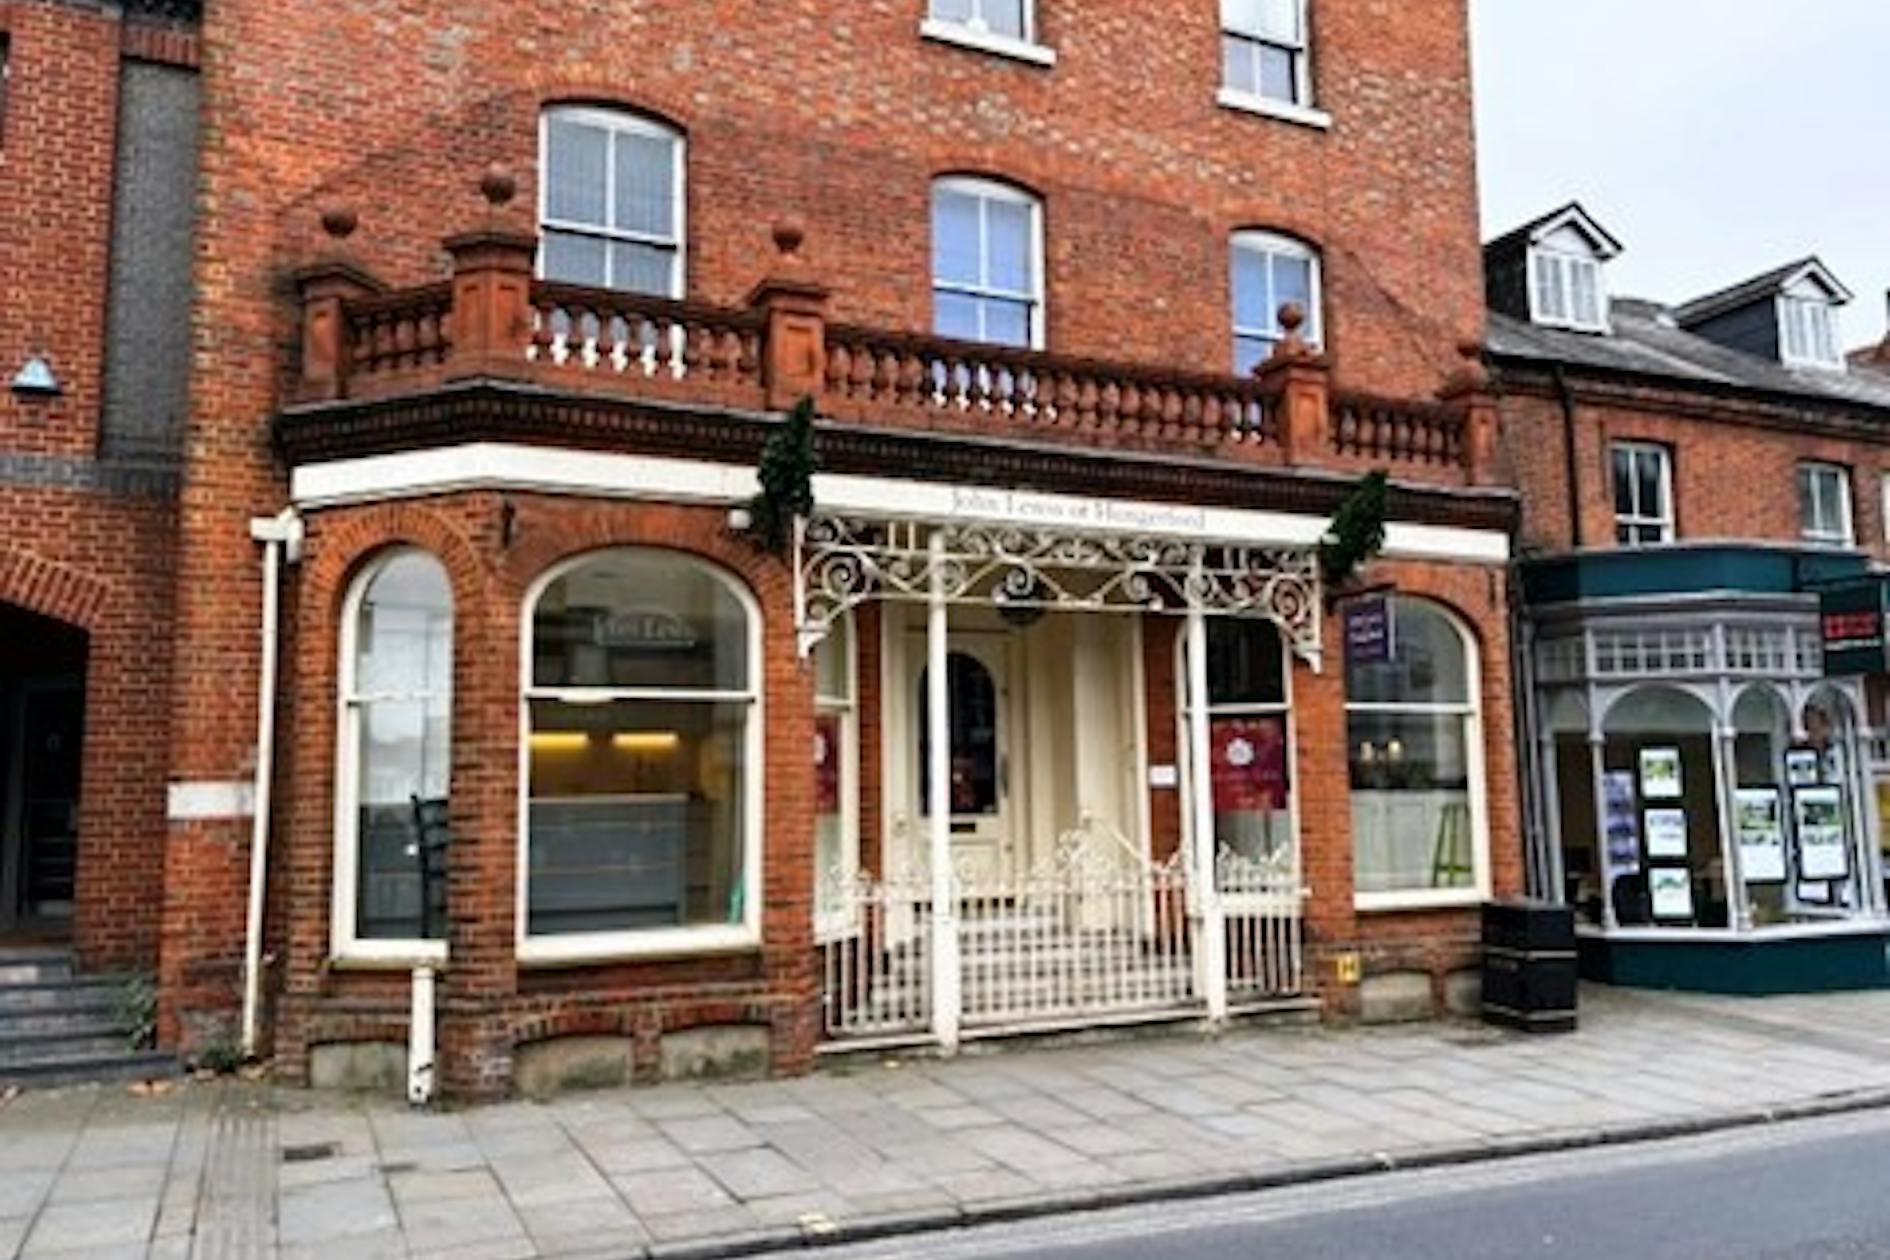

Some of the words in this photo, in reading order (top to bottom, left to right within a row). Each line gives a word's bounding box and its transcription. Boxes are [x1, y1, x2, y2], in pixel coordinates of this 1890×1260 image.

[952, 488, 999, 516] John
[1006, 493, 1063, 517] Lewis
[1067, 501, 1087, 518] of
